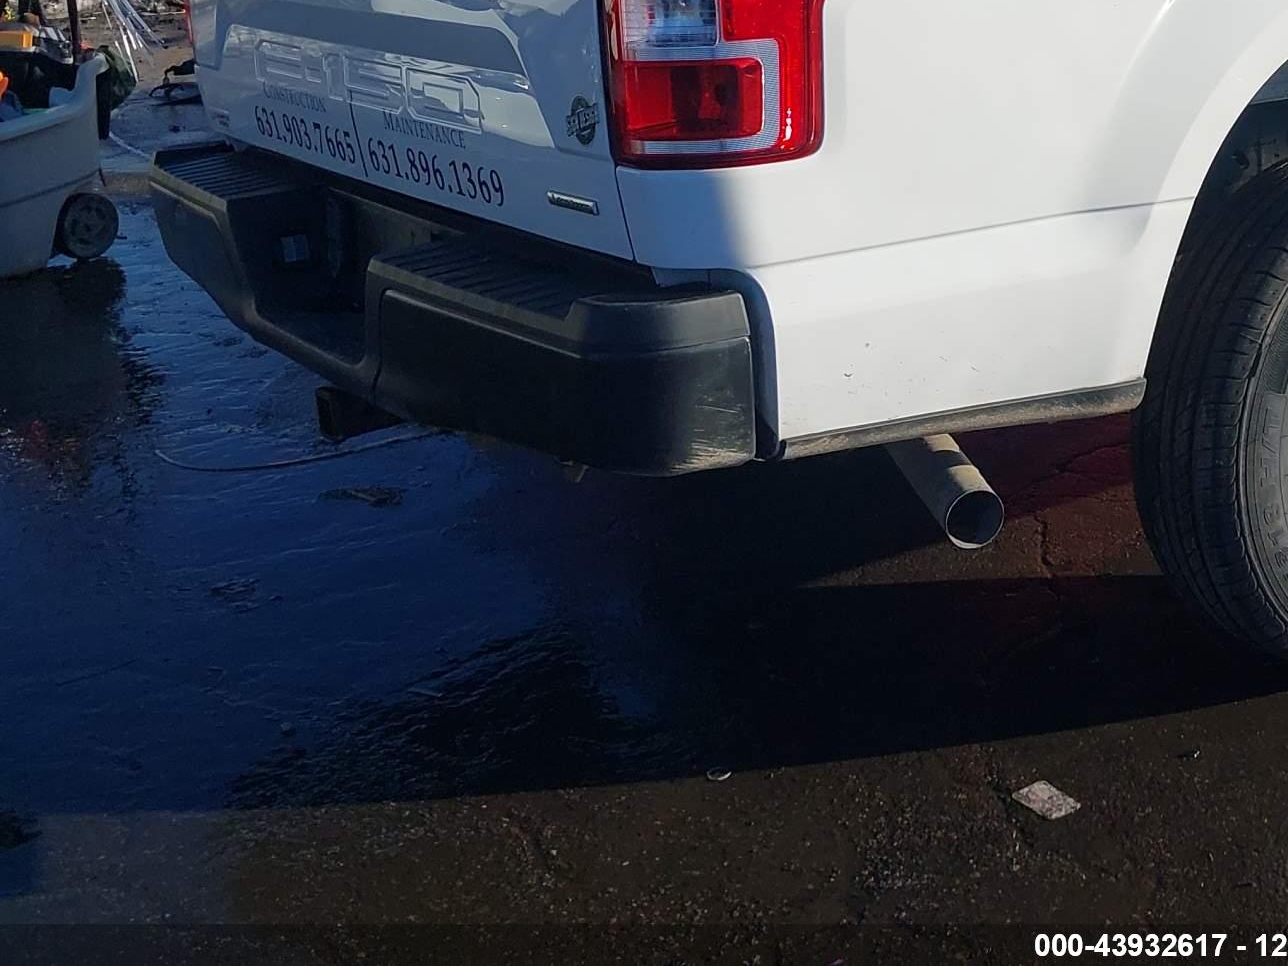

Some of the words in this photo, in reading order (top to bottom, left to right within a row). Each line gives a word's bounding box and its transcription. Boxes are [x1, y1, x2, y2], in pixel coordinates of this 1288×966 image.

[263, 81, 327, 114] CONSTRUCTION
[383, 110, 466, 149] MAINTENANCE
[254, 105, 357, 164] 631.903.7665
[368, 138, 505, 208] 631.896.1369
